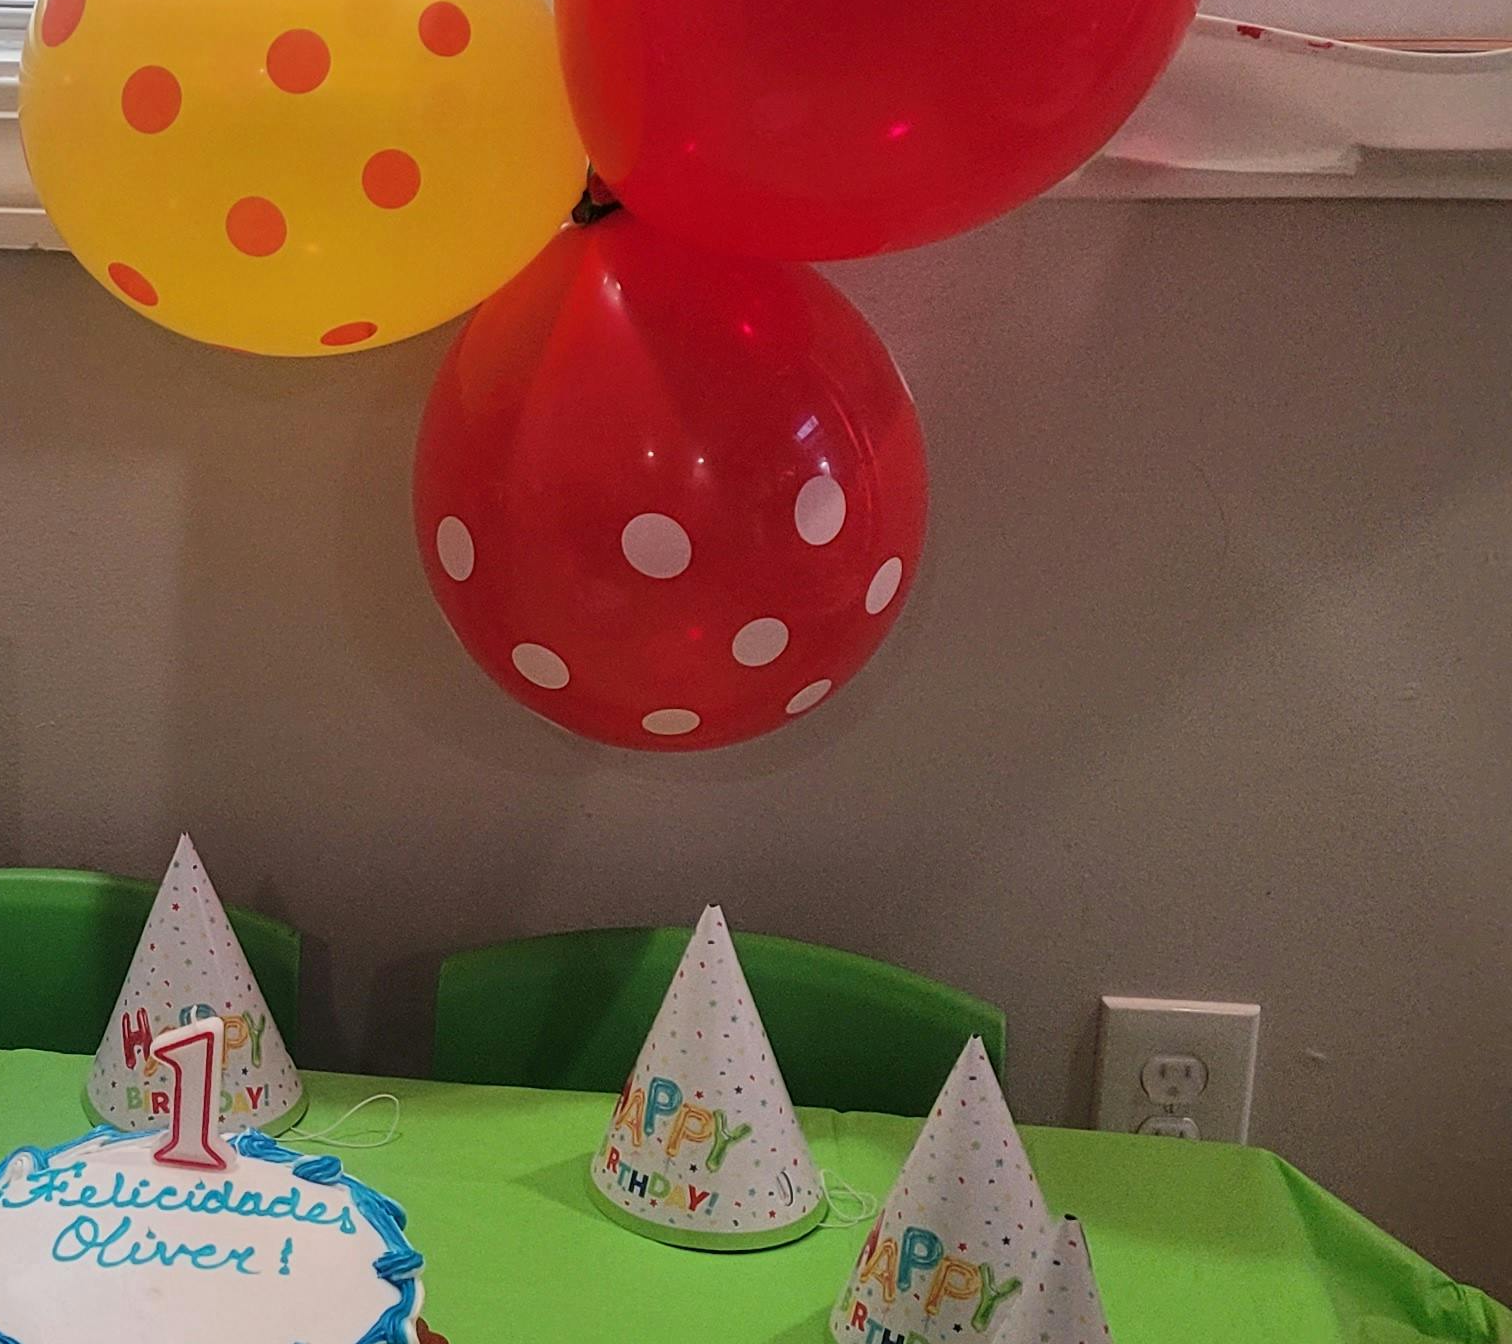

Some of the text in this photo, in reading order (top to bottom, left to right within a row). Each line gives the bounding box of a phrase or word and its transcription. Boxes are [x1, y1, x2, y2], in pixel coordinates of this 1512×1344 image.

[122, 1001, 266, 1077] HPY
[126, 1083, 269, 1115] BIRDAY!
[613, 1074, 753, 1173] APPY
[606, 1146, 720, 1216] RTHDAY!
